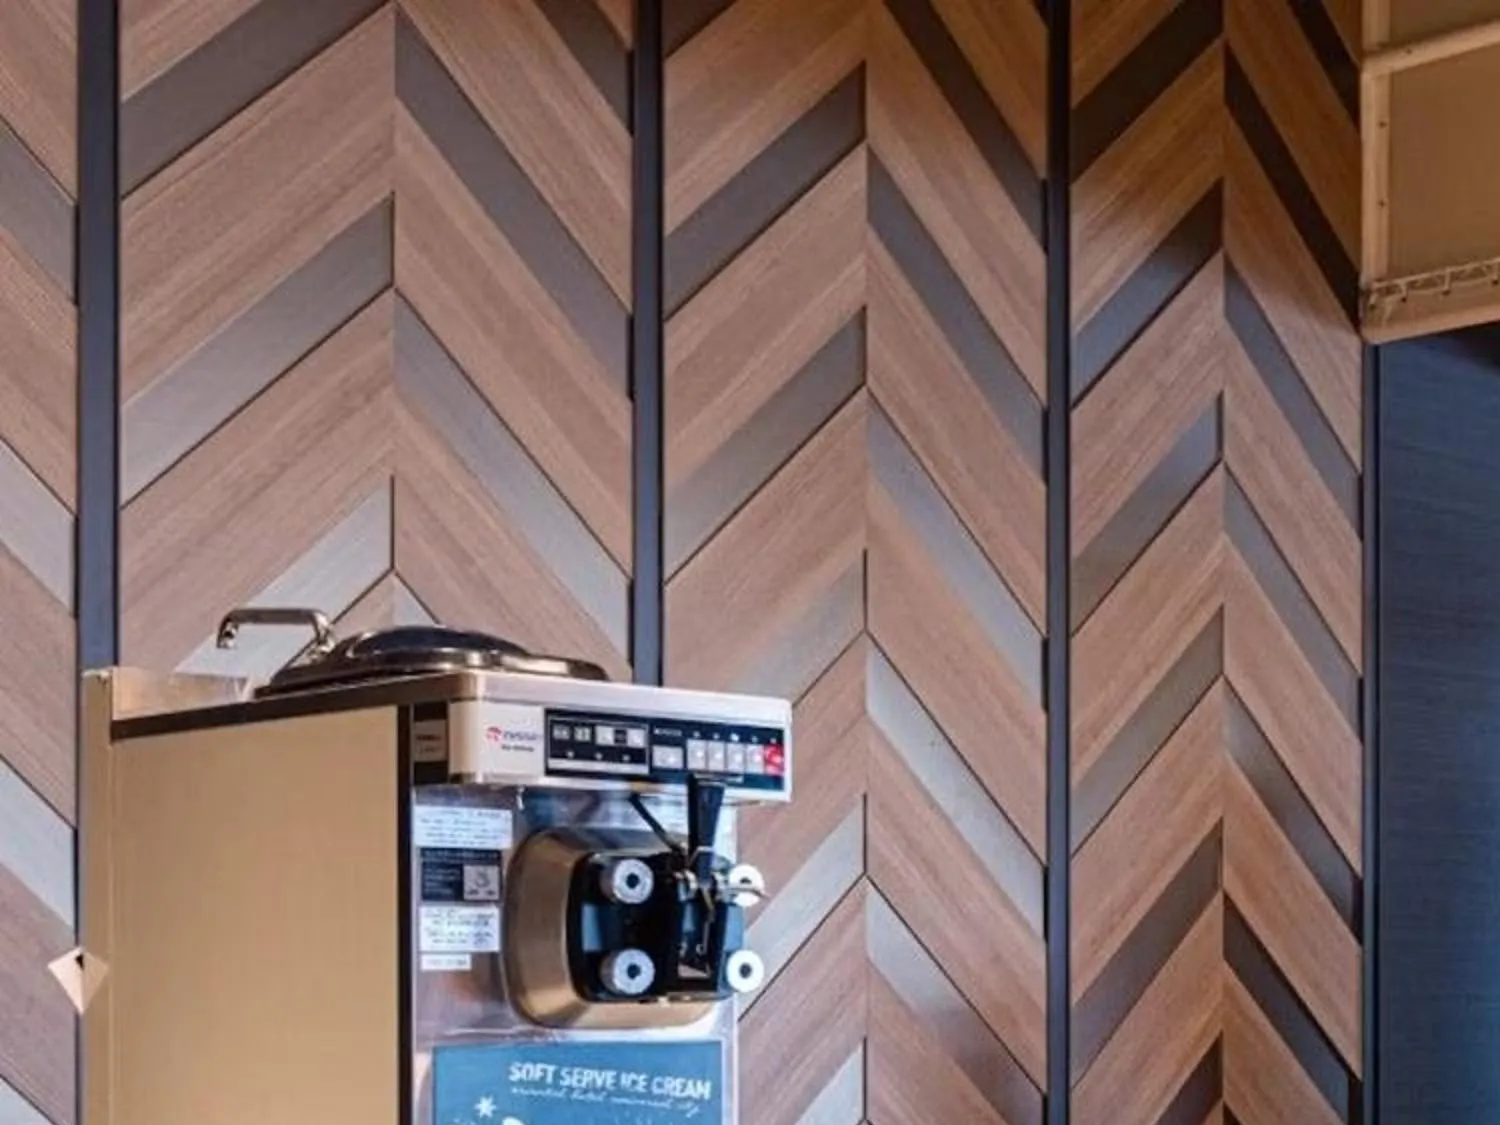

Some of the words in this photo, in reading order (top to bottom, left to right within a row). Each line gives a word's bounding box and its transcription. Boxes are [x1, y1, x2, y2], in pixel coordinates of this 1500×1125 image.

[508, 1062, 556, 1083] SOFT
[559, 1067, 617, 1090] SERVE
[620, 1072, 649, 1092] ICE
[652, 1077, 712, 1100] CREAM
